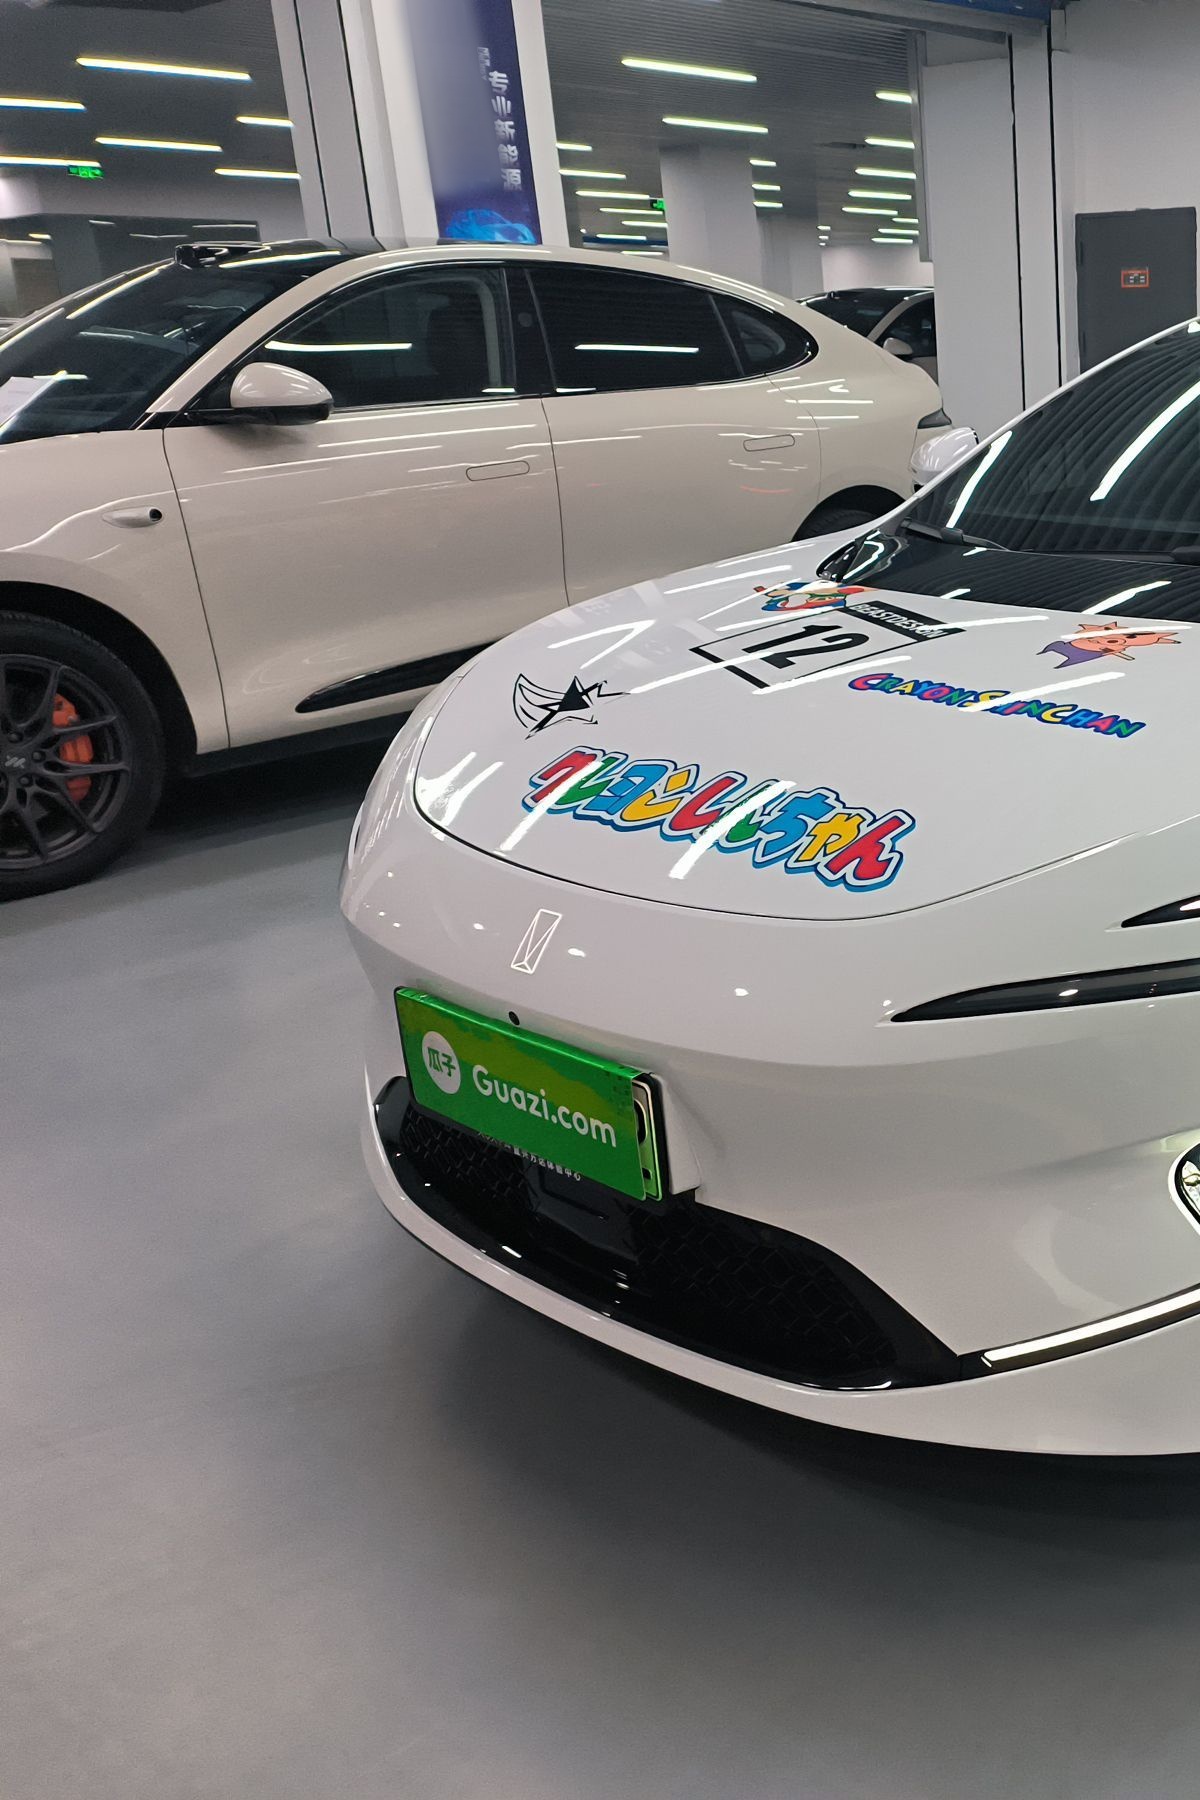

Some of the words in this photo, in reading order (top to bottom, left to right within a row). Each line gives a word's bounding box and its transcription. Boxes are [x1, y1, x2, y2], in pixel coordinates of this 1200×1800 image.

[488, 70, 522, 190] 专业新能源
[741, 624, 870, 669] 12
[848, 672, 974, 706] CRAYON
[959, 690, 1146, 738] SINCHAN
[427, 1046, 456, 1078] 瓜子
[472, 1064, 617, 1148] Guazi.com
